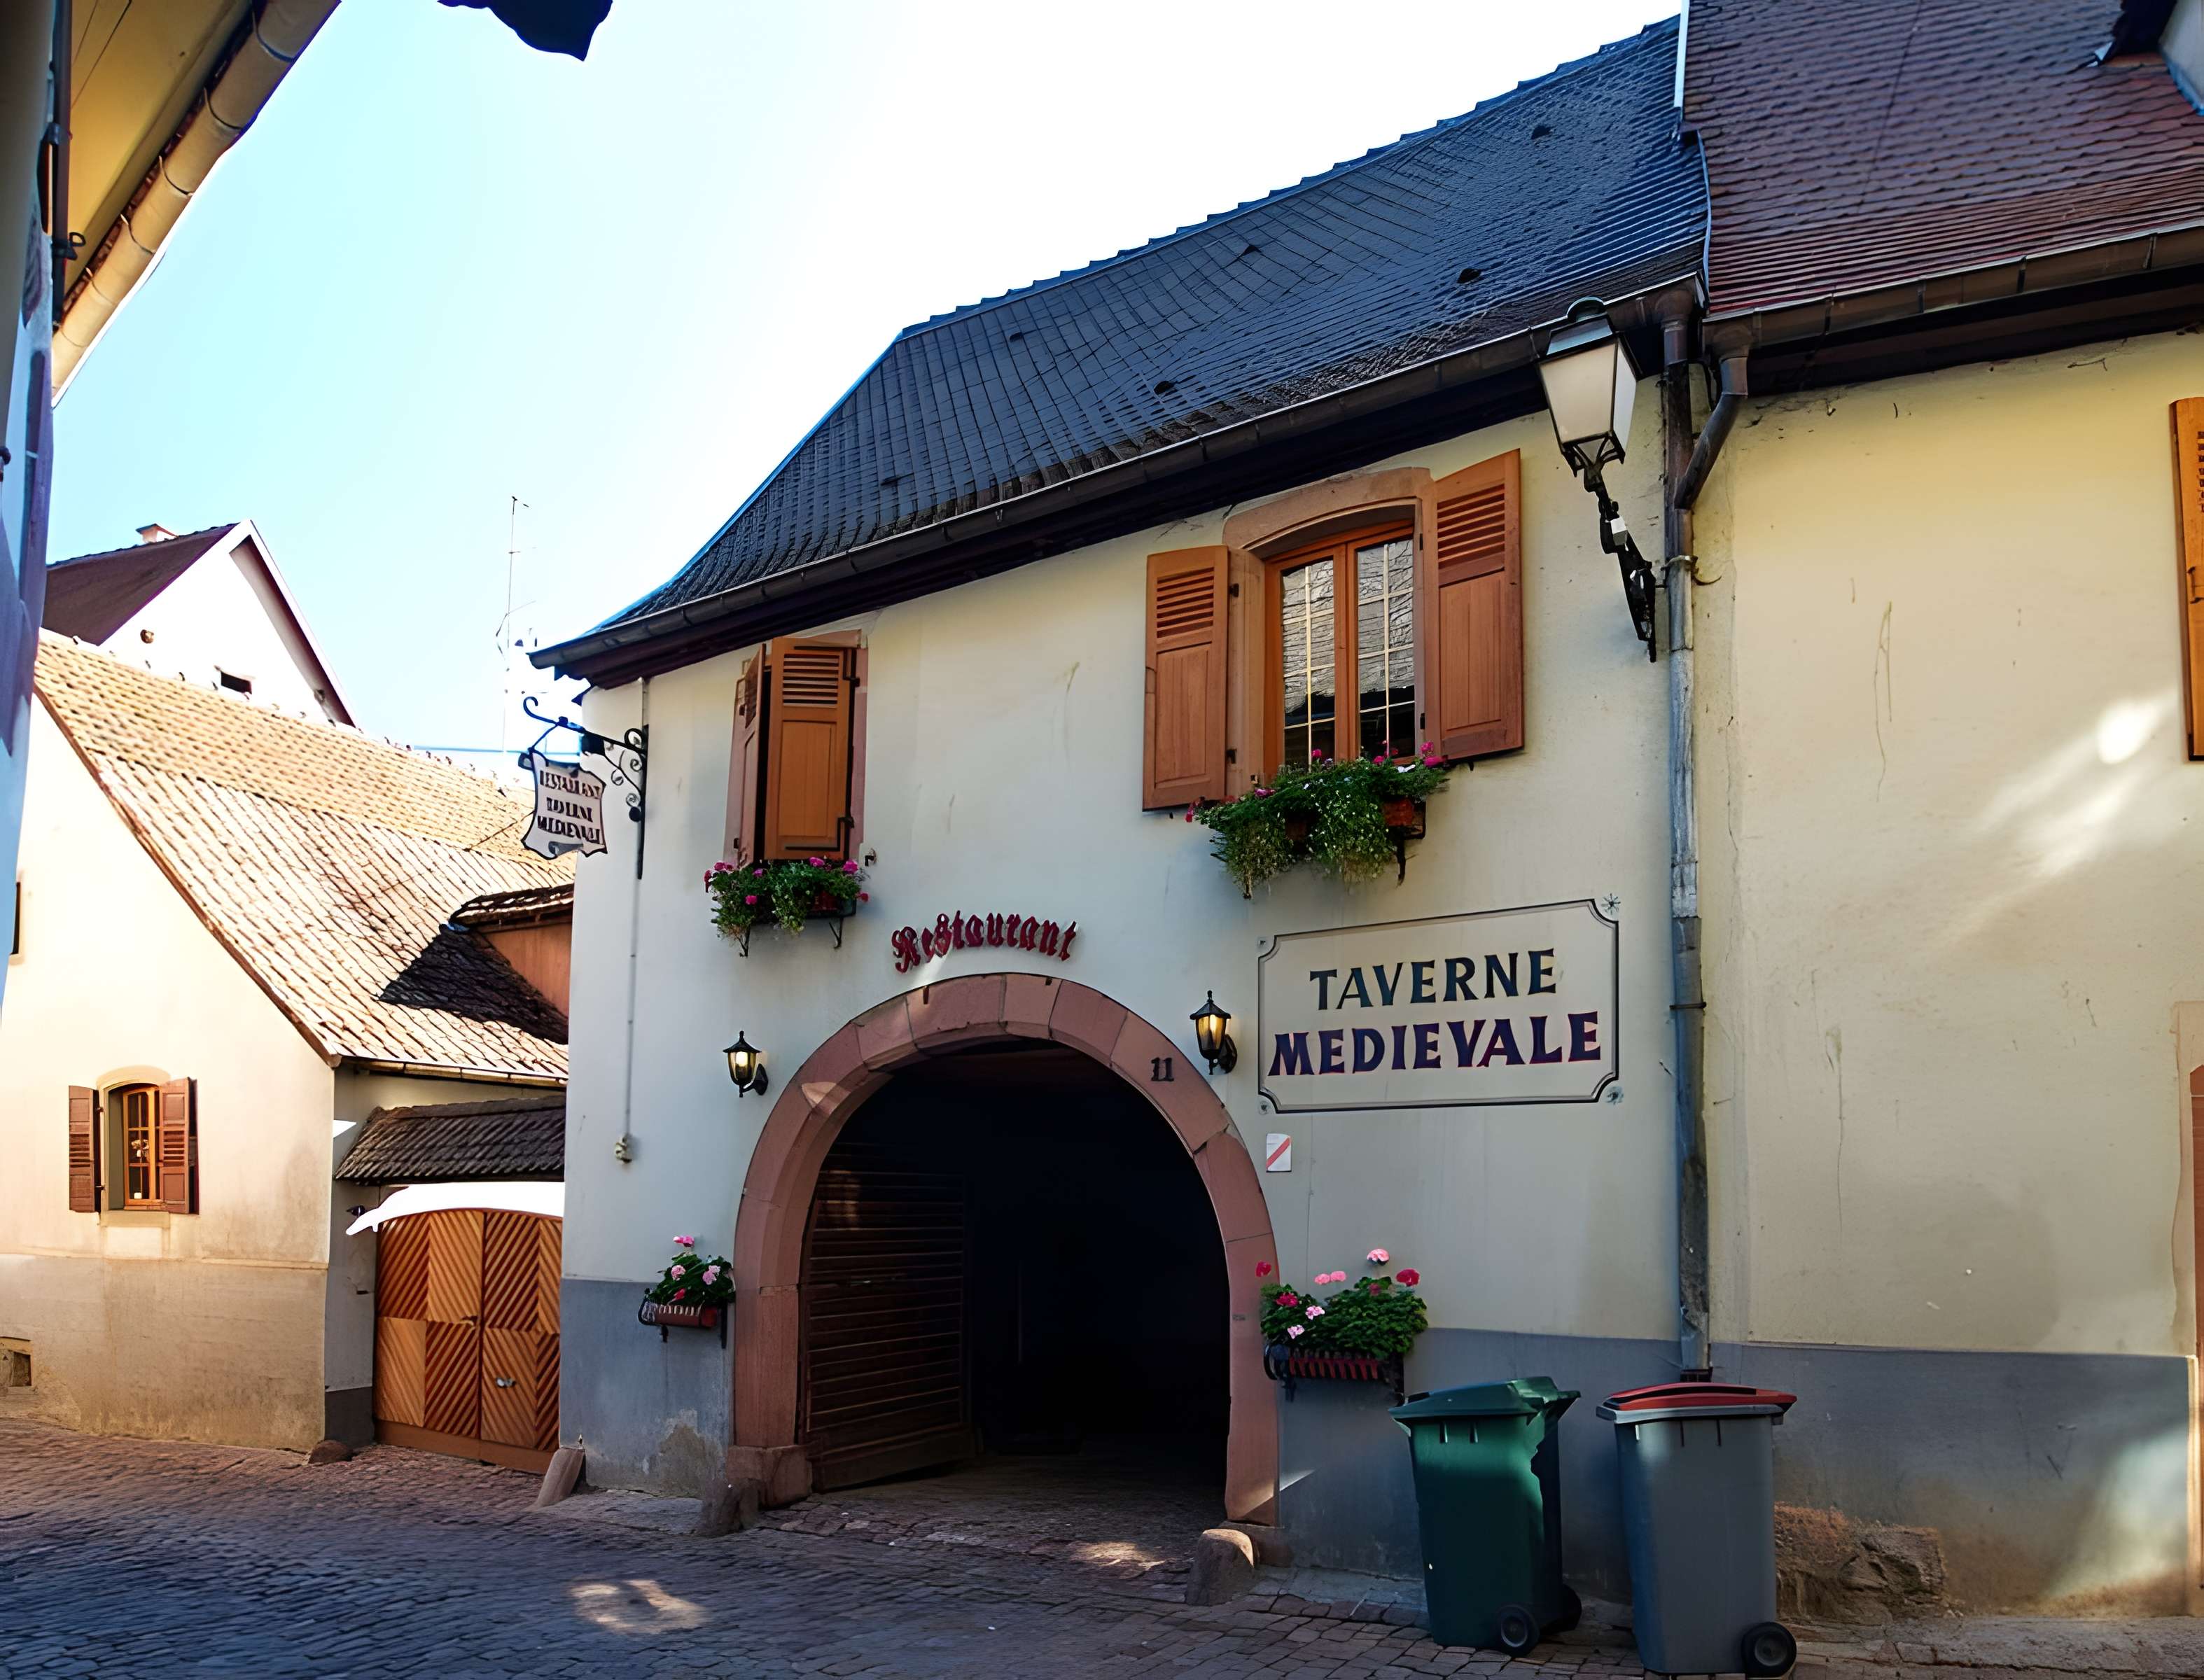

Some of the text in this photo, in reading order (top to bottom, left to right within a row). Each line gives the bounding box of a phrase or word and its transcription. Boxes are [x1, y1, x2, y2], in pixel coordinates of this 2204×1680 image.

[891, 910, 1077, 973] Restaurant
[1309, 948, 1557, 1010] TAVERNE
[1150, 1056, 1175, 1082] 11
[1267, 1011, 1601, 1076] MEDIEVALE
